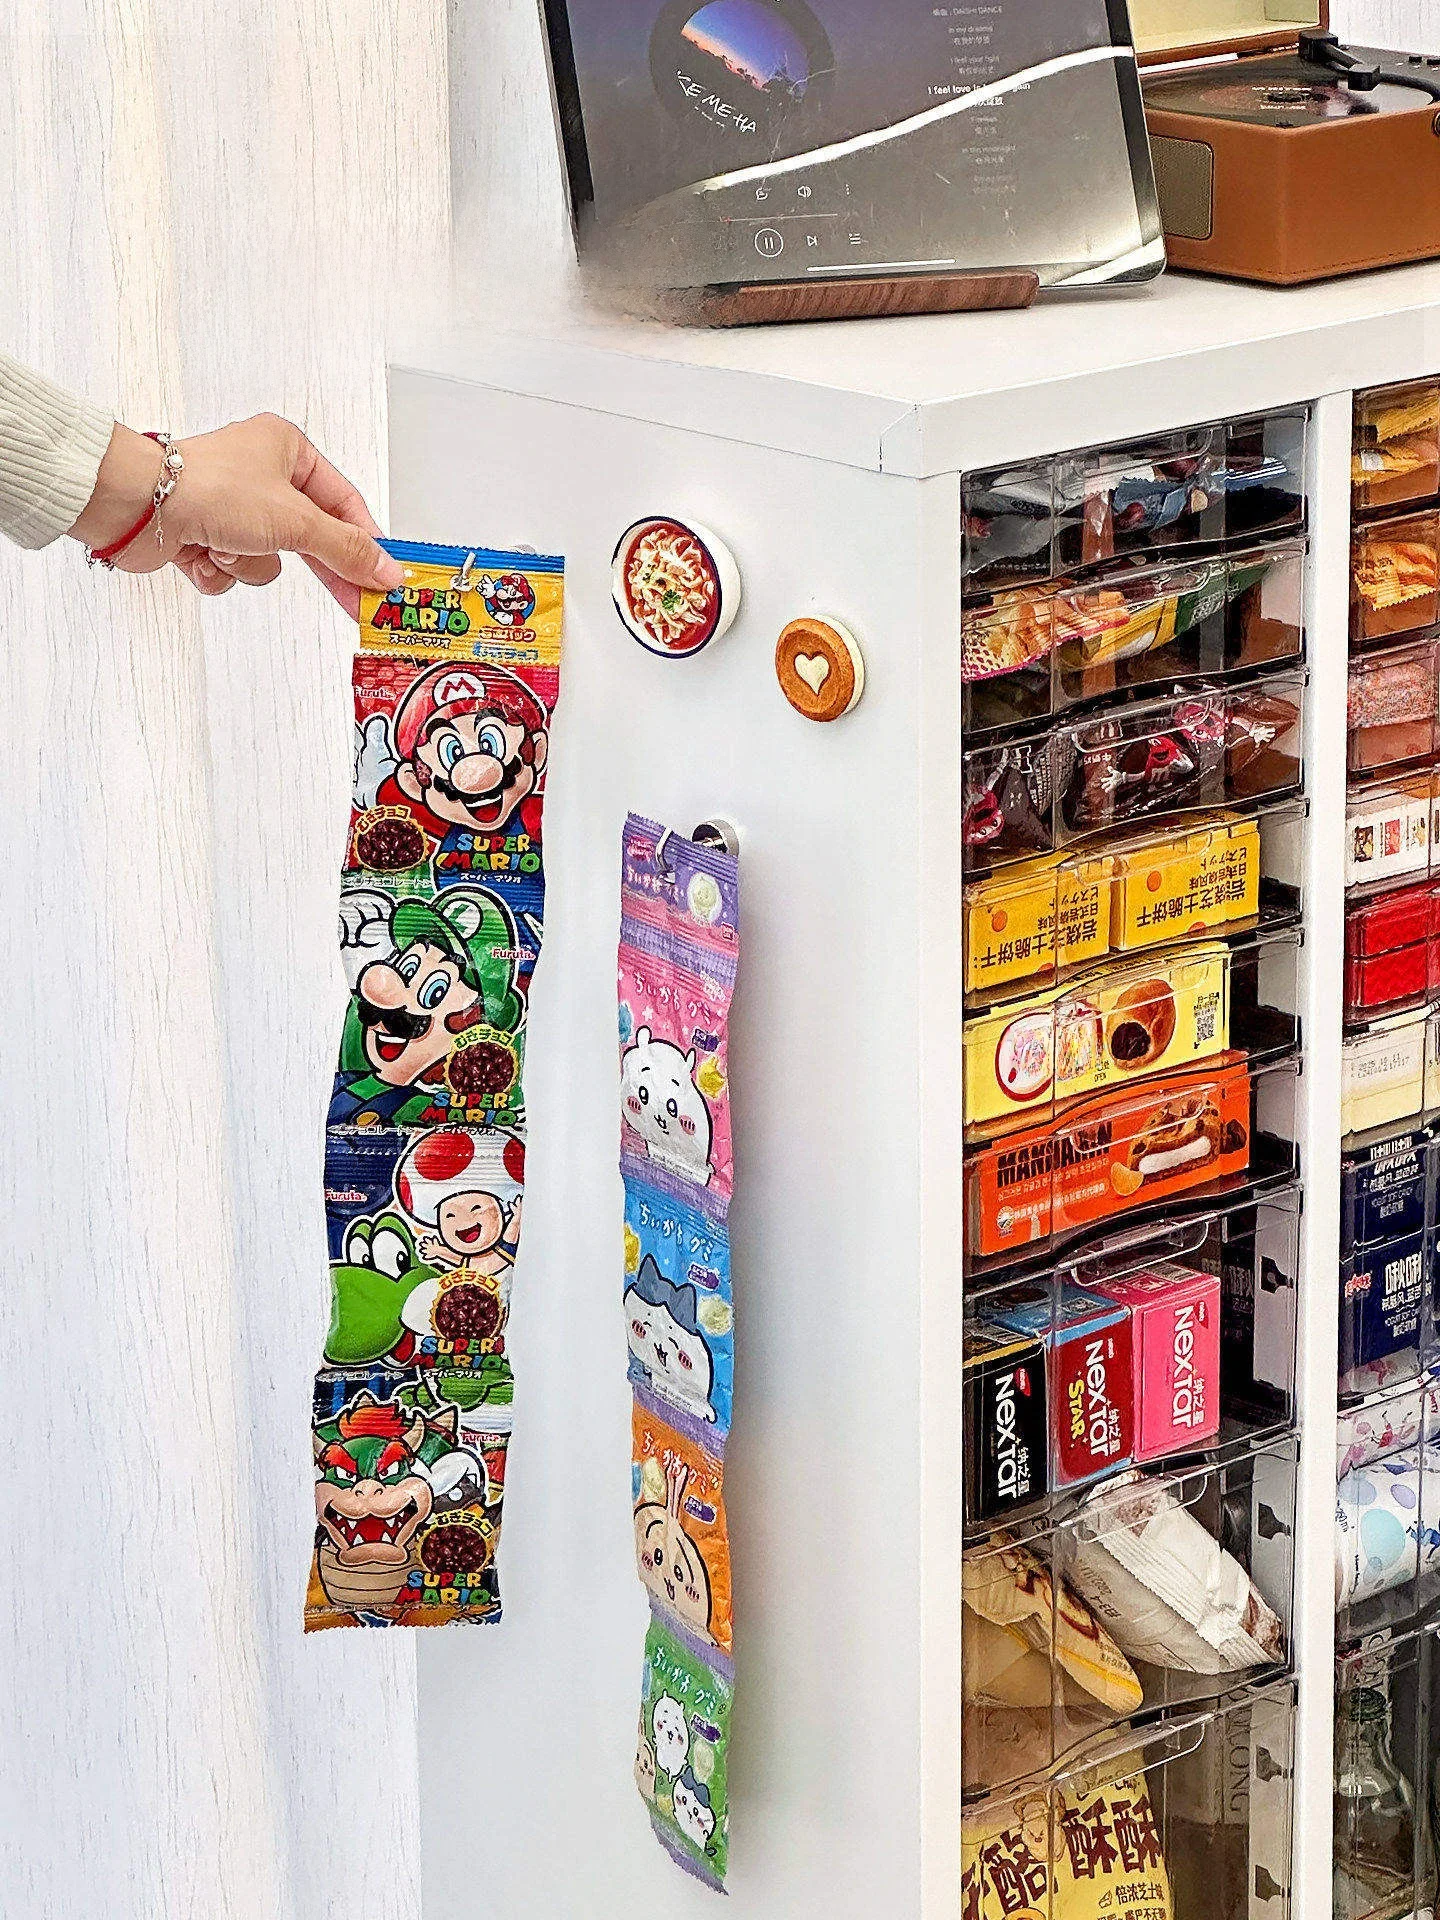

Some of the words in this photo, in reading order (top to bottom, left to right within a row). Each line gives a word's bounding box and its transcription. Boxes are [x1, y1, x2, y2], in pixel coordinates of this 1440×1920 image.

[932, 85, 951, 95] feel
[952, 84, 971, 94] love
[386, 586, 462, 610] SUPER
[370, 601, 471, 637] MARIO
[390, 633, 451, 649] スーパーマリオ
[457, 833, 531, 852] SUPER
[443, 852, 540, 873] MARIO
[460, 872, 522, 884] スーパーマリオ
[492, 948, 536, 960] Furuta
[434, 1092, 509, 1109] SUPER
[419, 1107, 517, 1126] MARIO
[325, 1188, 367, 1201] Furuta
[420, 1336, 497, 1355] SUPER
[411, 1354, 502, 1369] MARIO
[1068, 1378, 1086, 1440] STAR
[407, 1571, 482, 1587] SUPER
[399, 1587, 491, 1605] MARIO
